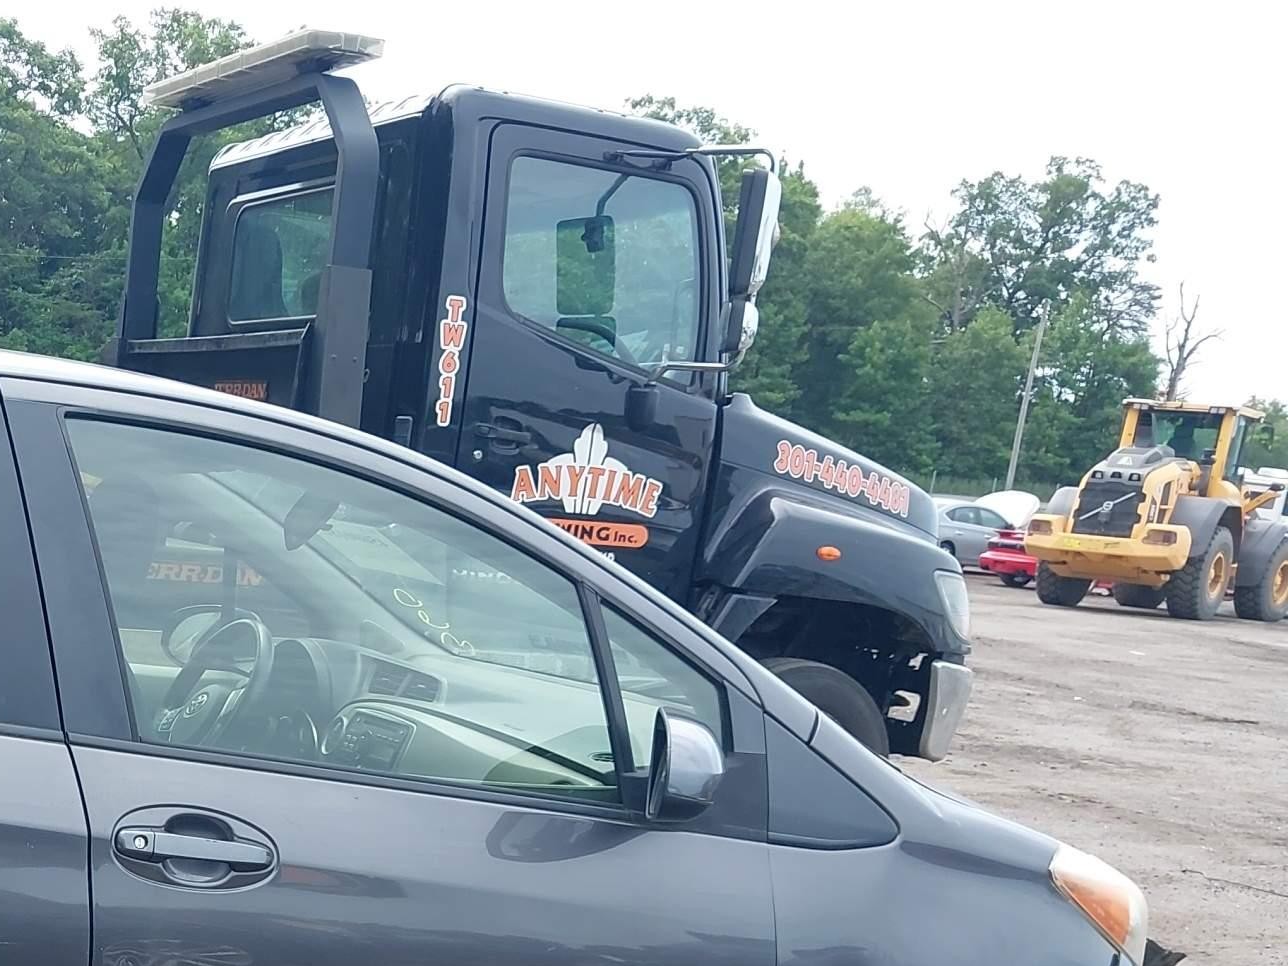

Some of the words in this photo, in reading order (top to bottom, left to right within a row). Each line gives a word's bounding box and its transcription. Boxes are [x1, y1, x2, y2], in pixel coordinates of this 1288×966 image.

[437, 296, 466, 425] TW611
[512, 464, 661, 518] ANYTIME
[775, 441, 909, 516] 301-440-4481
[613, 531, 638, 544] Inc.
